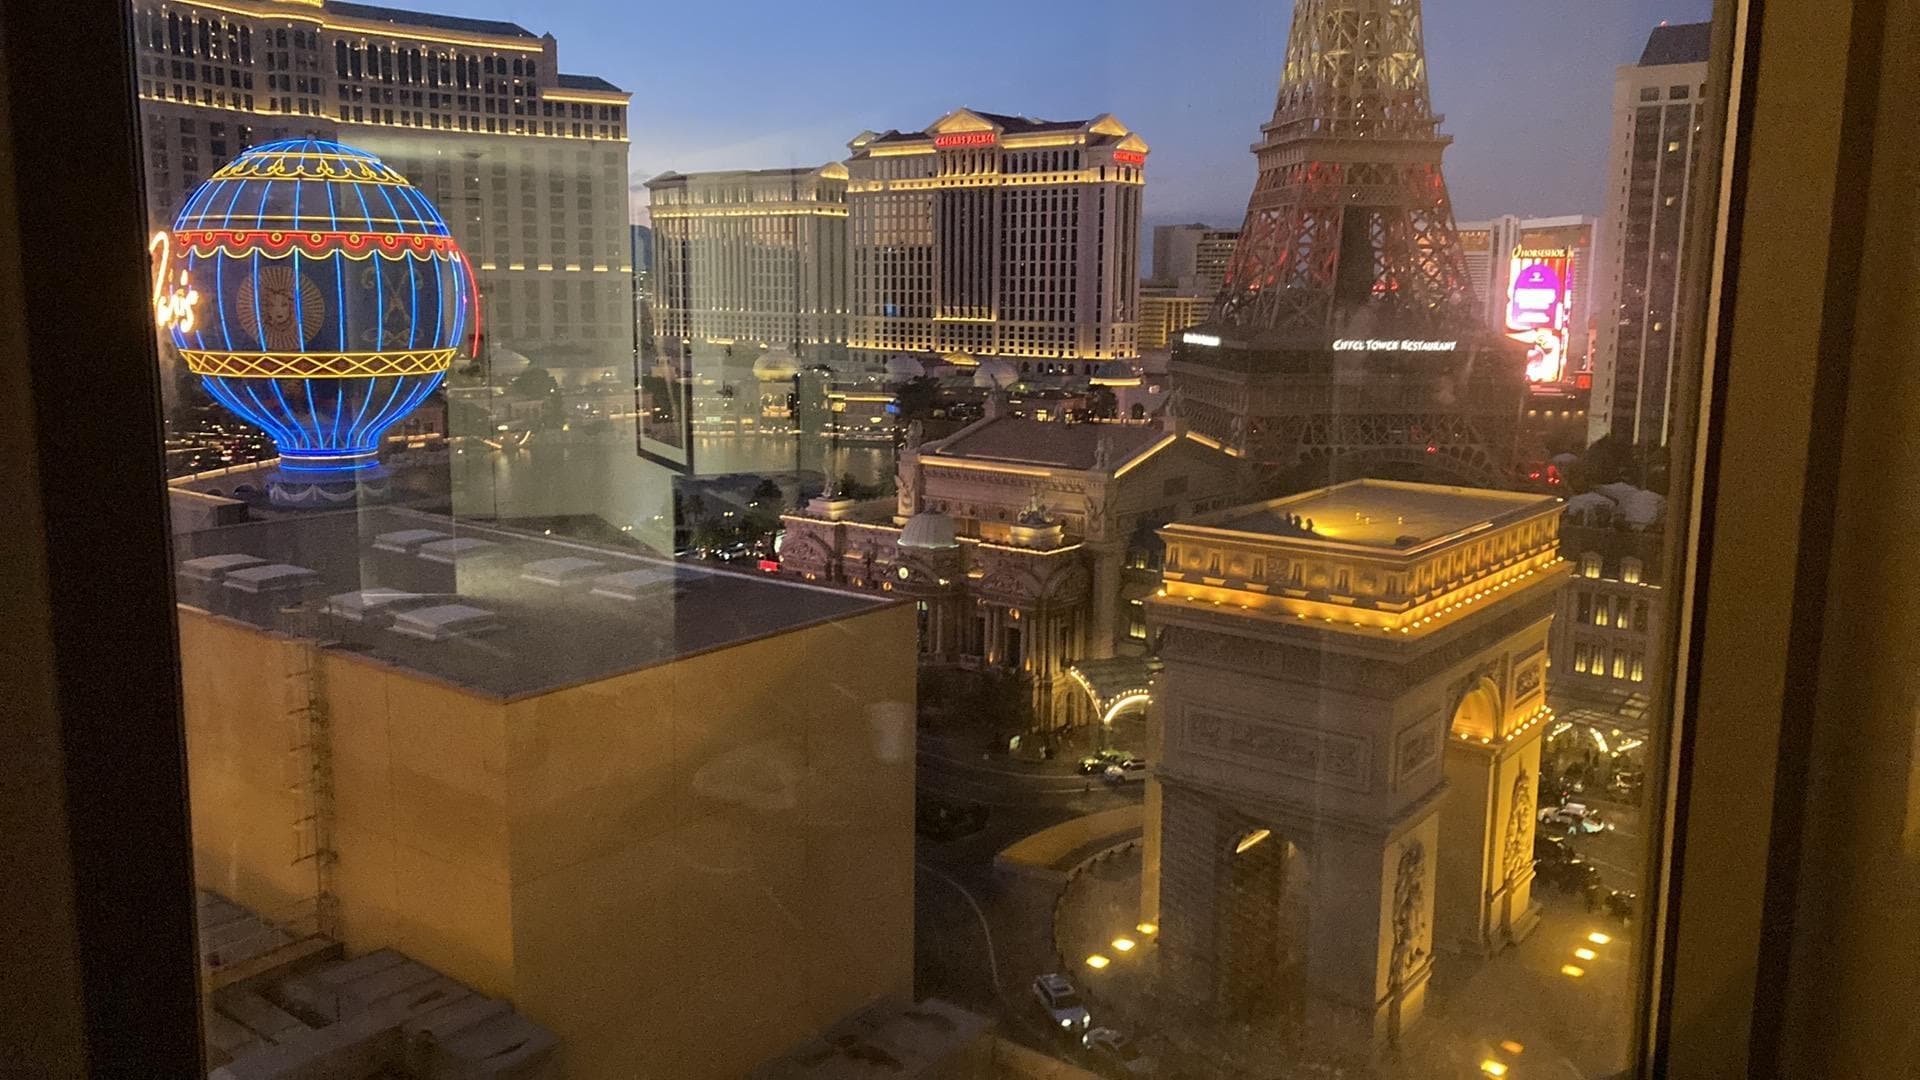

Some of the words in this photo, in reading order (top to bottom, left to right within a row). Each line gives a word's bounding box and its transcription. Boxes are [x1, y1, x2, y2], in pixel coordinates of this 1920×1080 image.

[1520, 248, 1566, 258] HORSESHOE
[1365, 339, 1399, 351] TOWER
[1400, 340, 1457, 351] RESTAURANT
